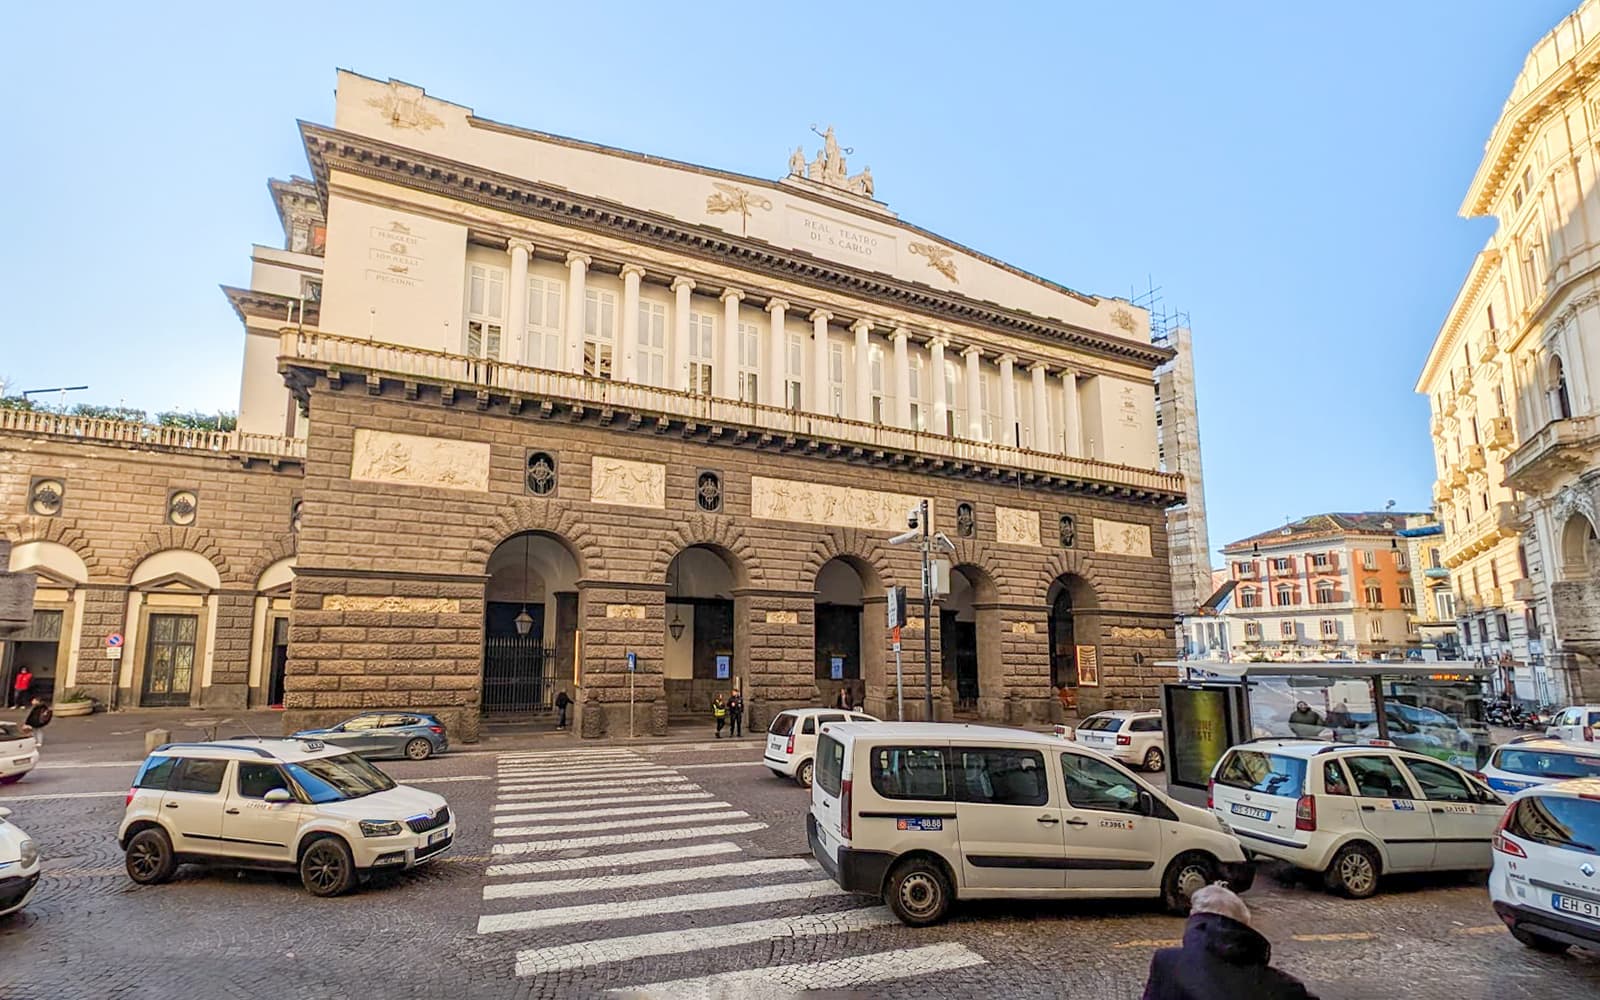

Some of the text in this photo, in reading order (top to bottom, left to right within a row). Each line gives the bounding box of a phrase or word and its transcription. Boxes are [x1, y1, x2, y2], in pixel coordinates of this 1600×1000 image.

[804, 219, 878, 247] REAL TEATRO
[810, 231, 821, 242] DI
[838, 240, 872, 256] CARLO
[1562, 897, 1579, 911] EH
